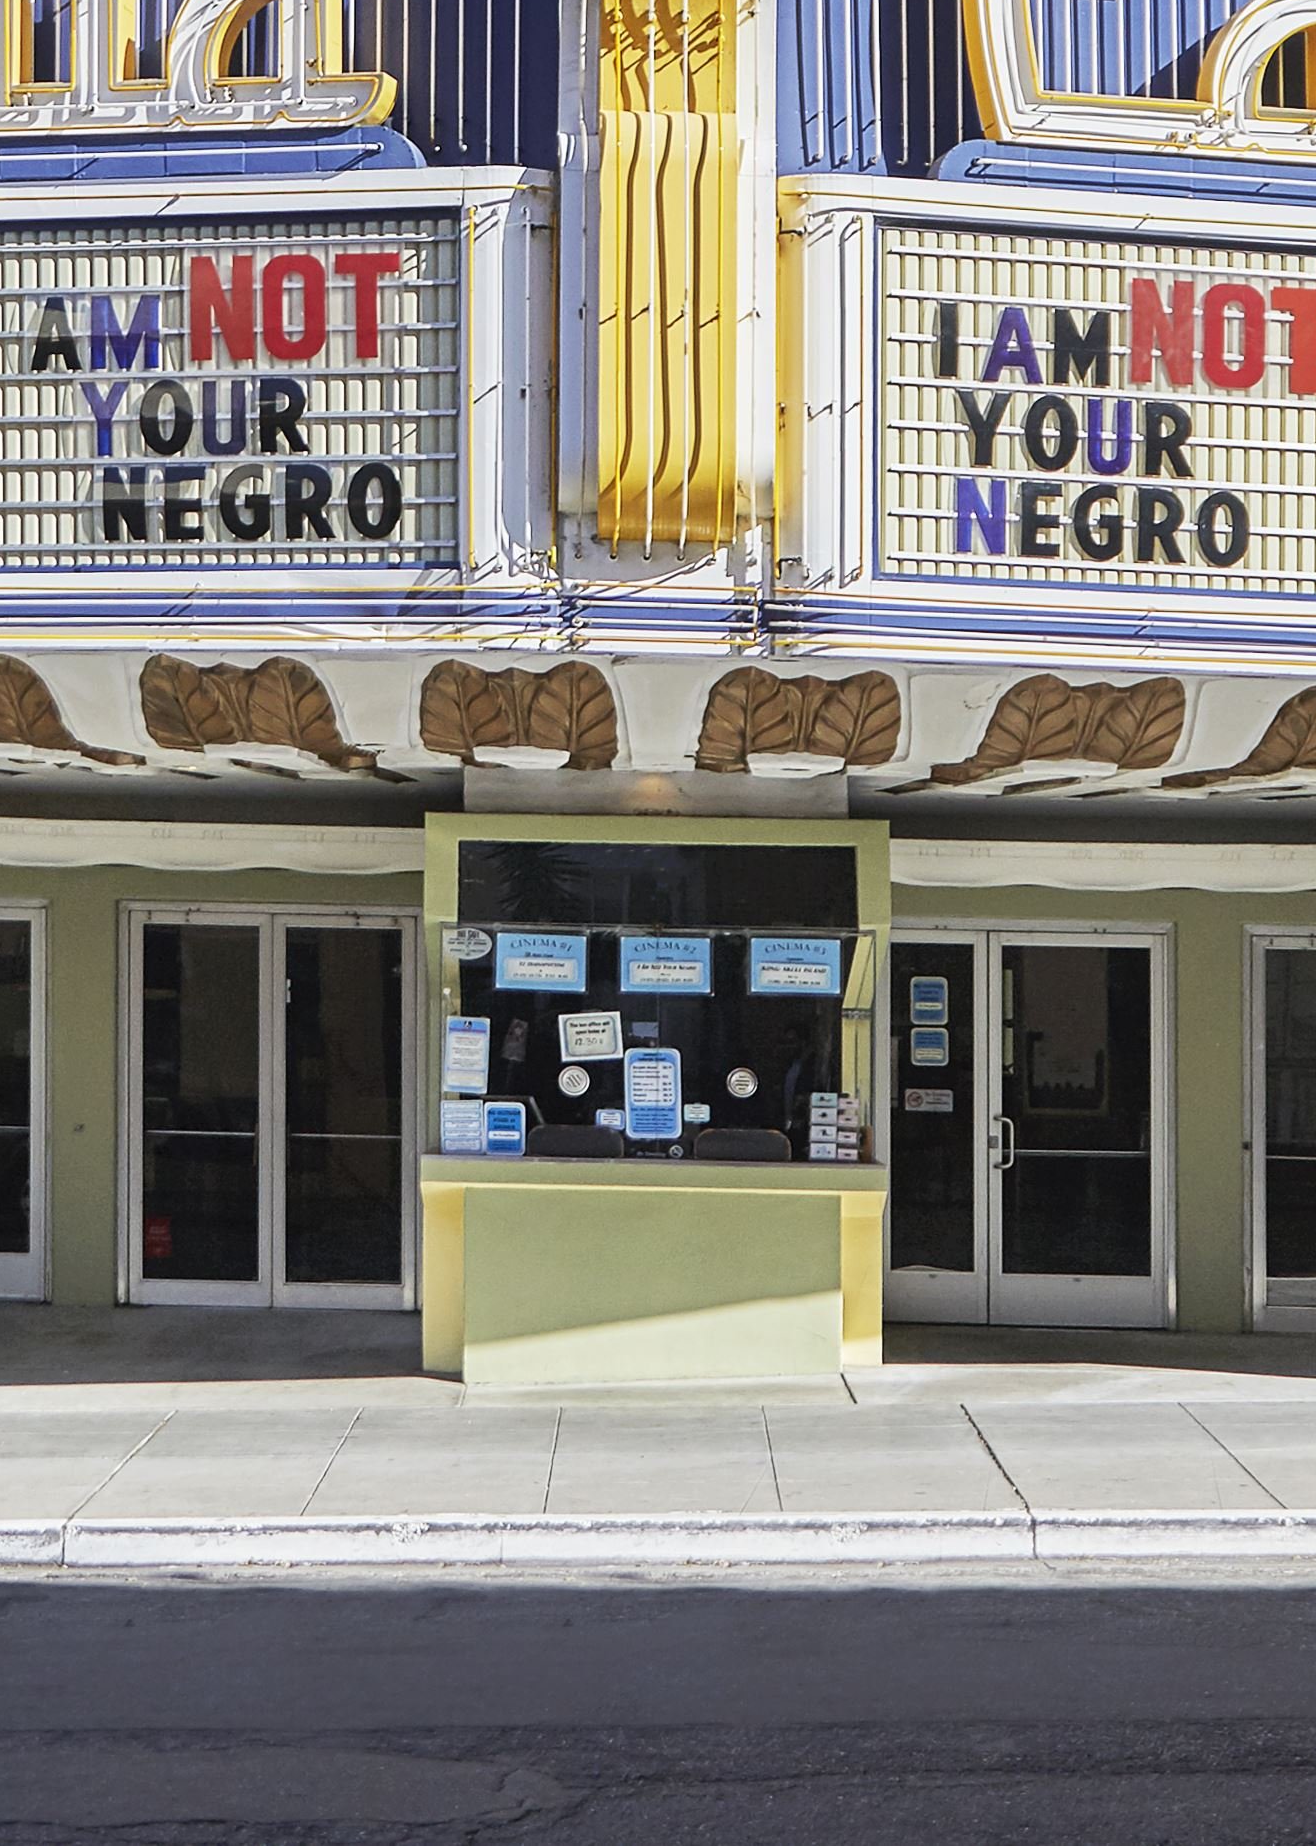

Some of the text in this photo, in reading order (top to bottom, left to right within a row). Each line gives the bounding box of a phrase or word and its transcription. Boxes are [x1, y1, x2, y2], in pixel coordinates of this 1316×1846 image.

[31, 295, 161, 371] AM
[190, 251, 401, 362] NOT
[937, 301, 959, 380] I
[980, 307, 1112, 387] AM
[84, 378, 310, 458] YOUR
[954, 389, 1194, 479] YOUR
[102, 460, 404, 542] NEGRO
[955, 477, 1252, 567] NEGRO
[510, 938, 558, 949] CINEMA
[634, 941, 681, 953] CINEMA
[765, 942, 811, 954] CINEMA
